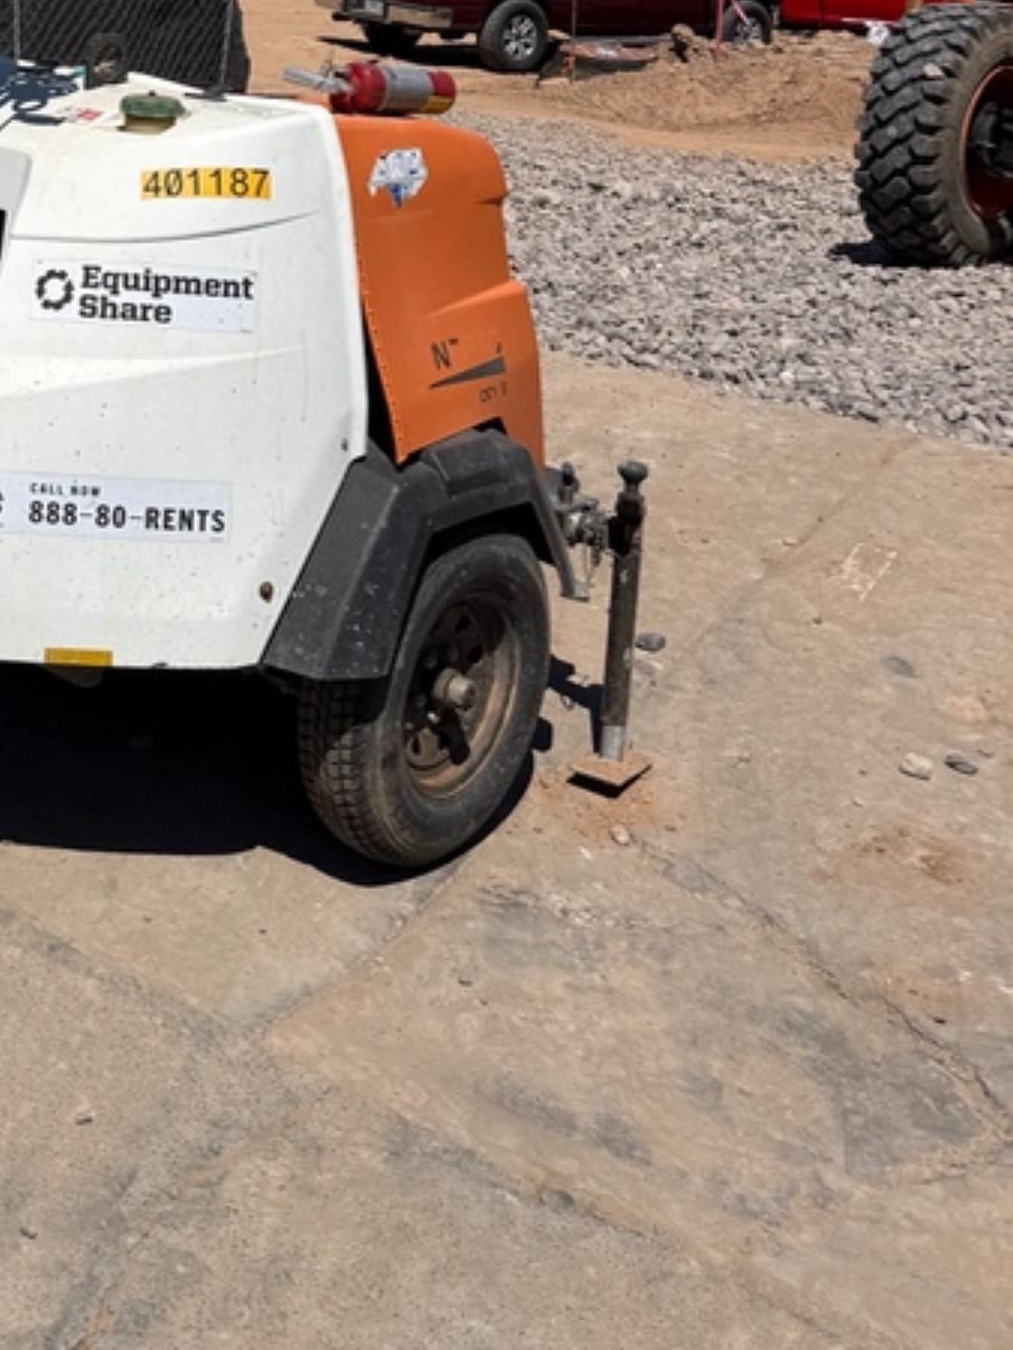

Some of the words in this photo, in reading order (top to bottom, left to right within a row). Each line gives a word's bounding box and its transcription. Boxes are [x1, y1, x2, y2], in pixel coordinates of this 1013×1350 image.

[142, 167, 270, 198] 401187
[81, 265, 254, 300] Equipment
[79, 294, 172, 324] Share
[29, 482, 63, 496] CALL
[70, 485, 101, 498] NOW
[28, 500, 226, 532] 888-80-RENTS
